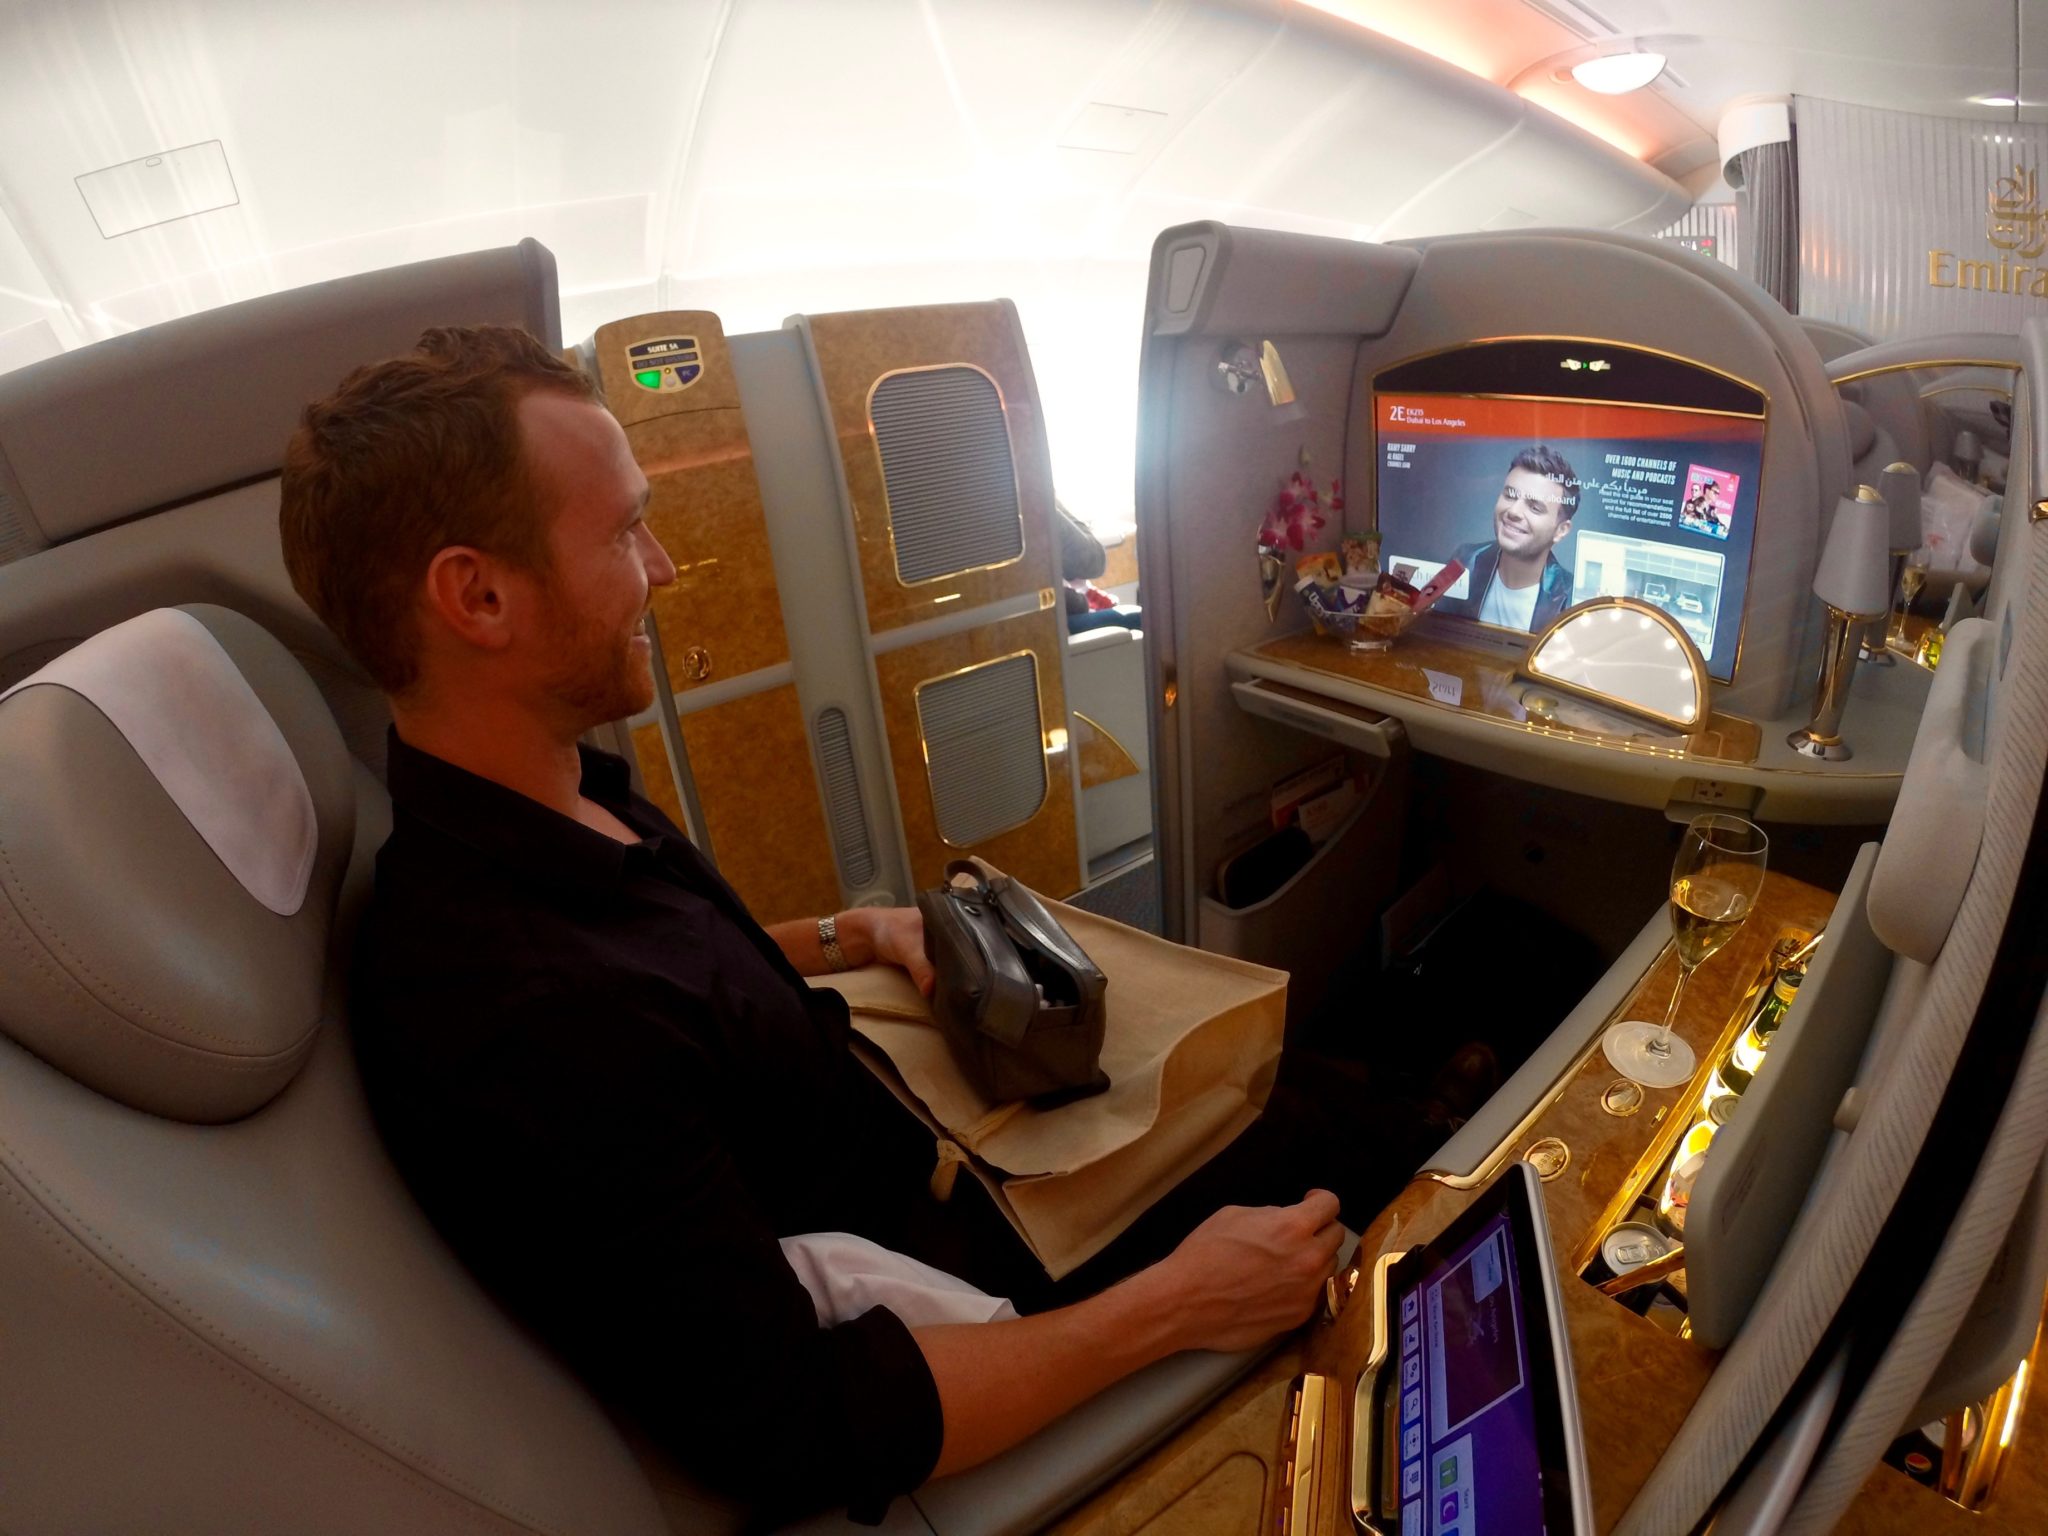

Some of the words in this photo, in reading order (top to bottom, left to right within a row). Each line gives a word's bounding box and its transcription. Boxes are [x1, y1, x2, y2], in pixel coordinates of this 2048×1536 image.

[647, 344, 667, 354] SUITE
[1390, 406, 1406, 422] 2E
[1406, 416, 1424, 424] Dubai
[1442, 418, 1466, 428] Angeles
[1604, 454, 1620, 464] OVER
[1636, 457, 1668, 470] CHANNELS
[1668, 460, 1678, 472] OF
[1612, 468, 1632, 478] MUSIC
[1632, 470, 1644, 480] AND
[1645, 472, 1676, 486] PODCASTS
